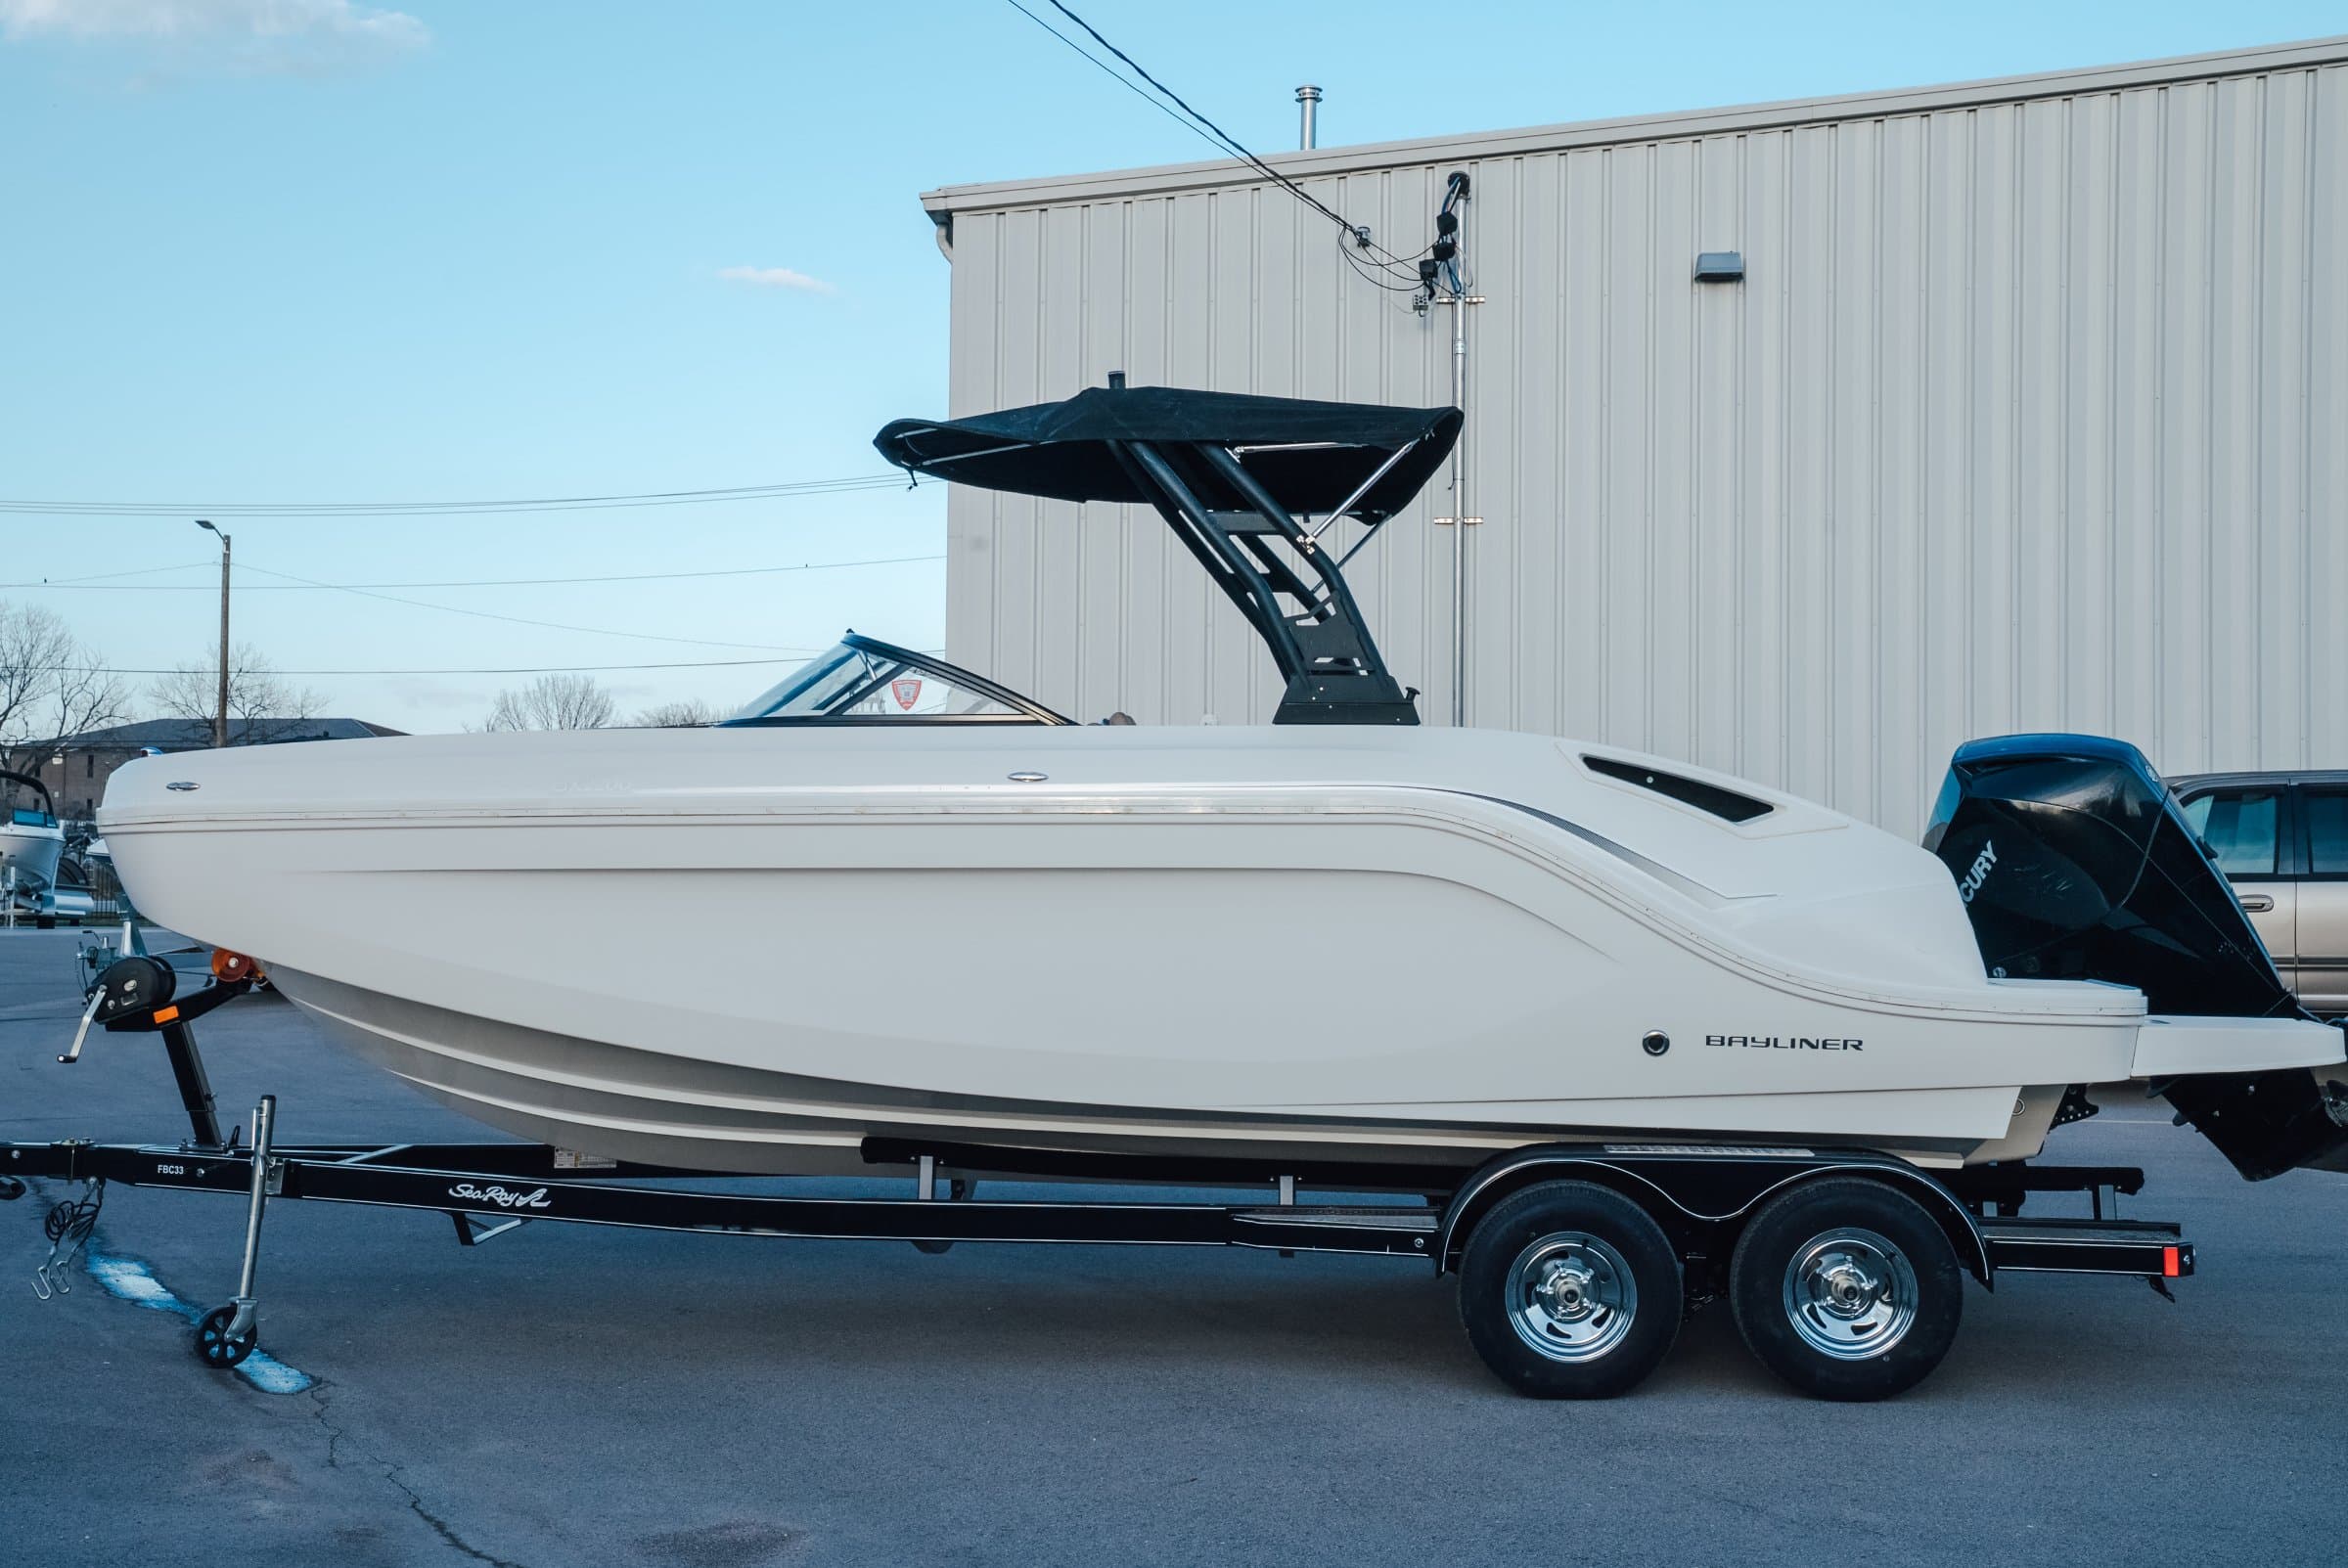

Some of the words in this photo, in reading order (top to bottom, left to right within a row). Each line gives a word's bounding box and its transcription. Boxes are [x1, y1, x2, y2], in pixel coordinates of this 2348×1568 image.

[1959, 839, 1998, 909] CURY
[1705, 1035, 1864, 1052] BAYLINER
[158, 1164, 184, 1175] FBC33
[449, 1184, 484, 1199] Sea
[482, 1187, 519, 1207] Ray
